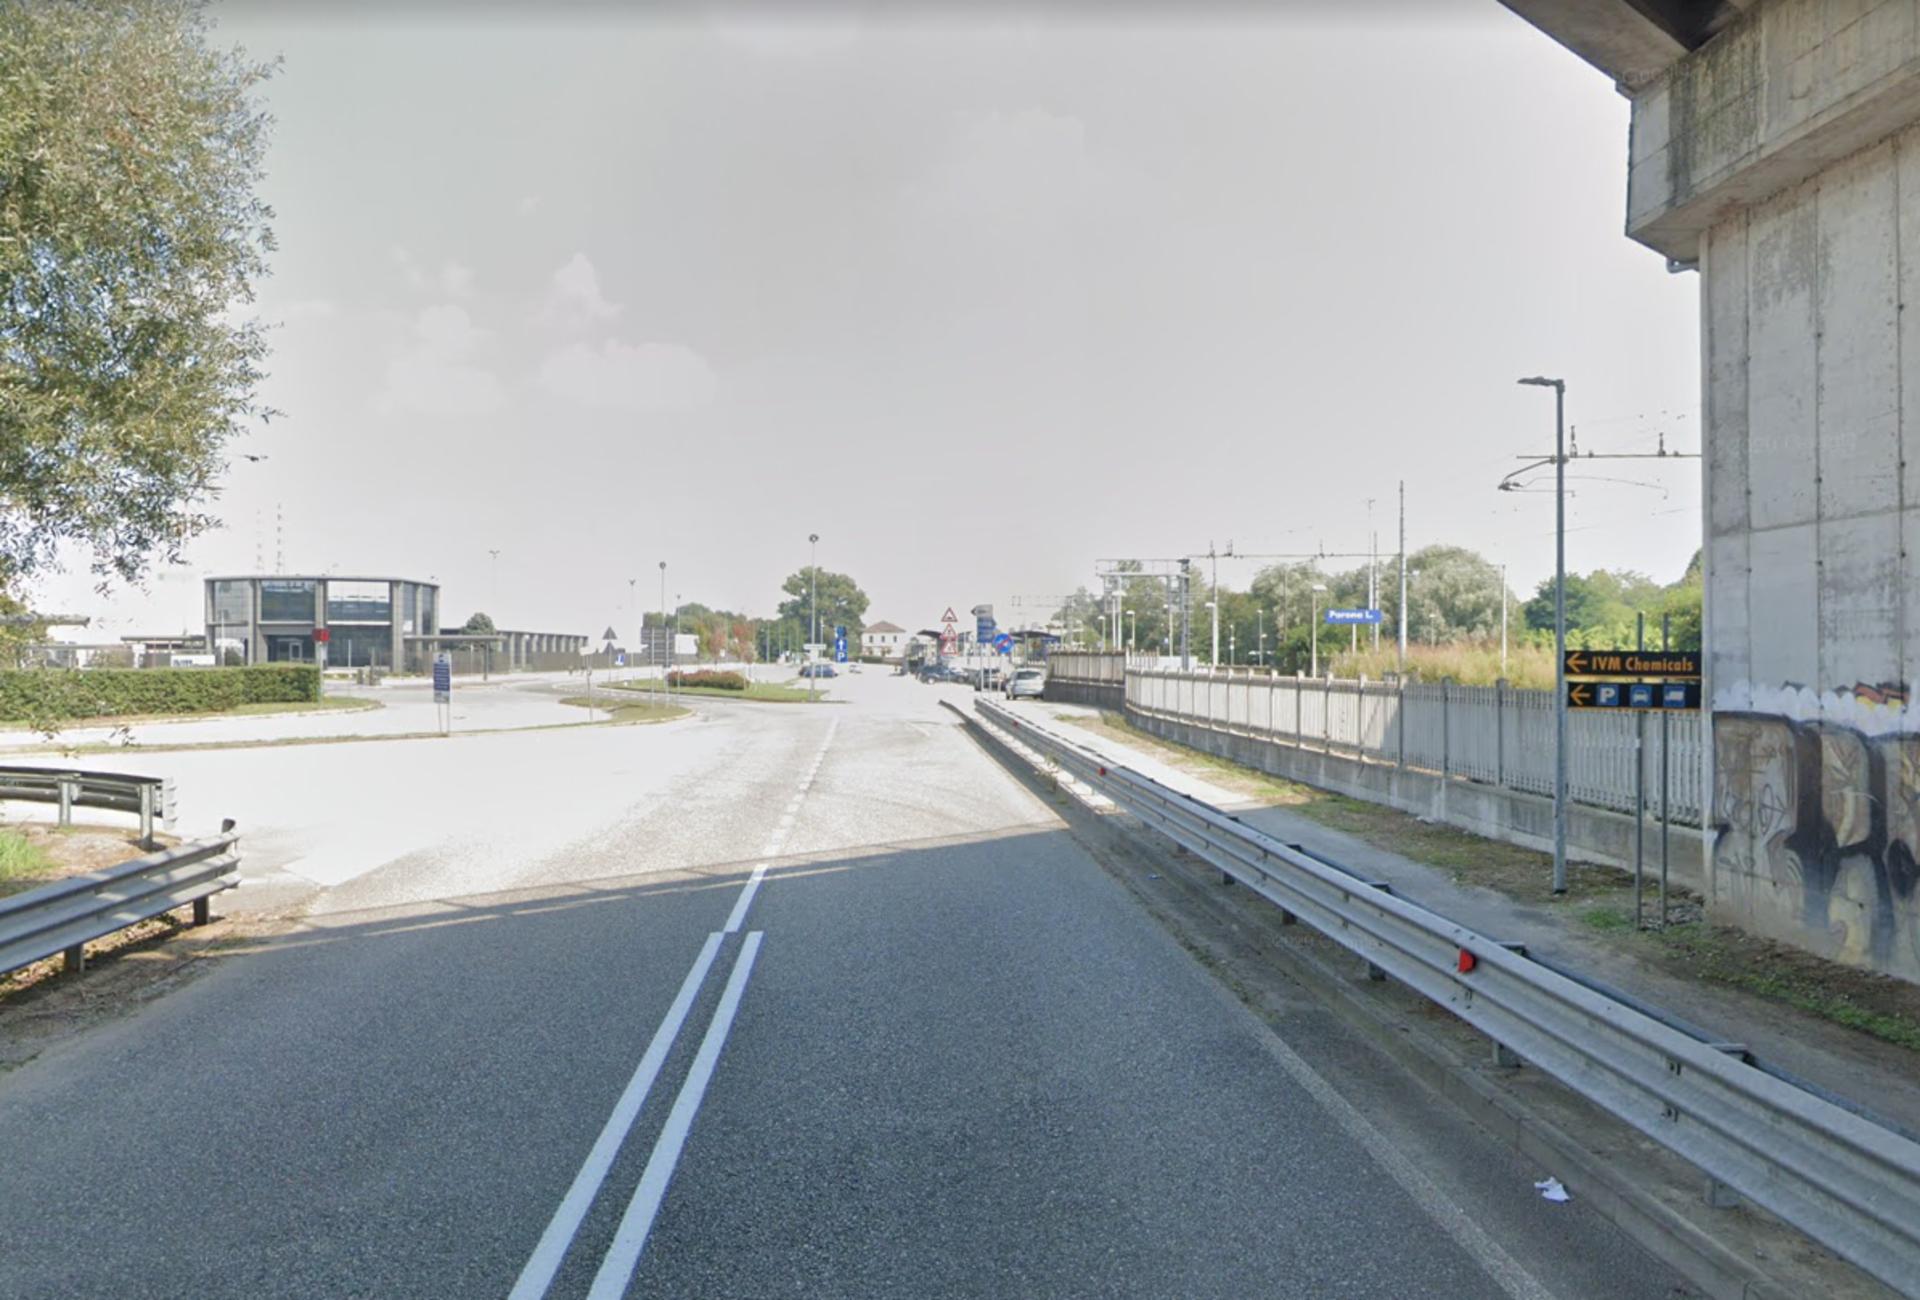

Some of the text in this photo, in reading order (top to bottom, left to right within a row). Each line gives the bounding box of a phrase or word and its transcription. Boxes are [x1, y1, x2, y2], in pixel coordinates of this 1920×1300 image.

[1592, 656, 1694, 672] IVM Chemicals
[1600, 687, 1616, 703] P
